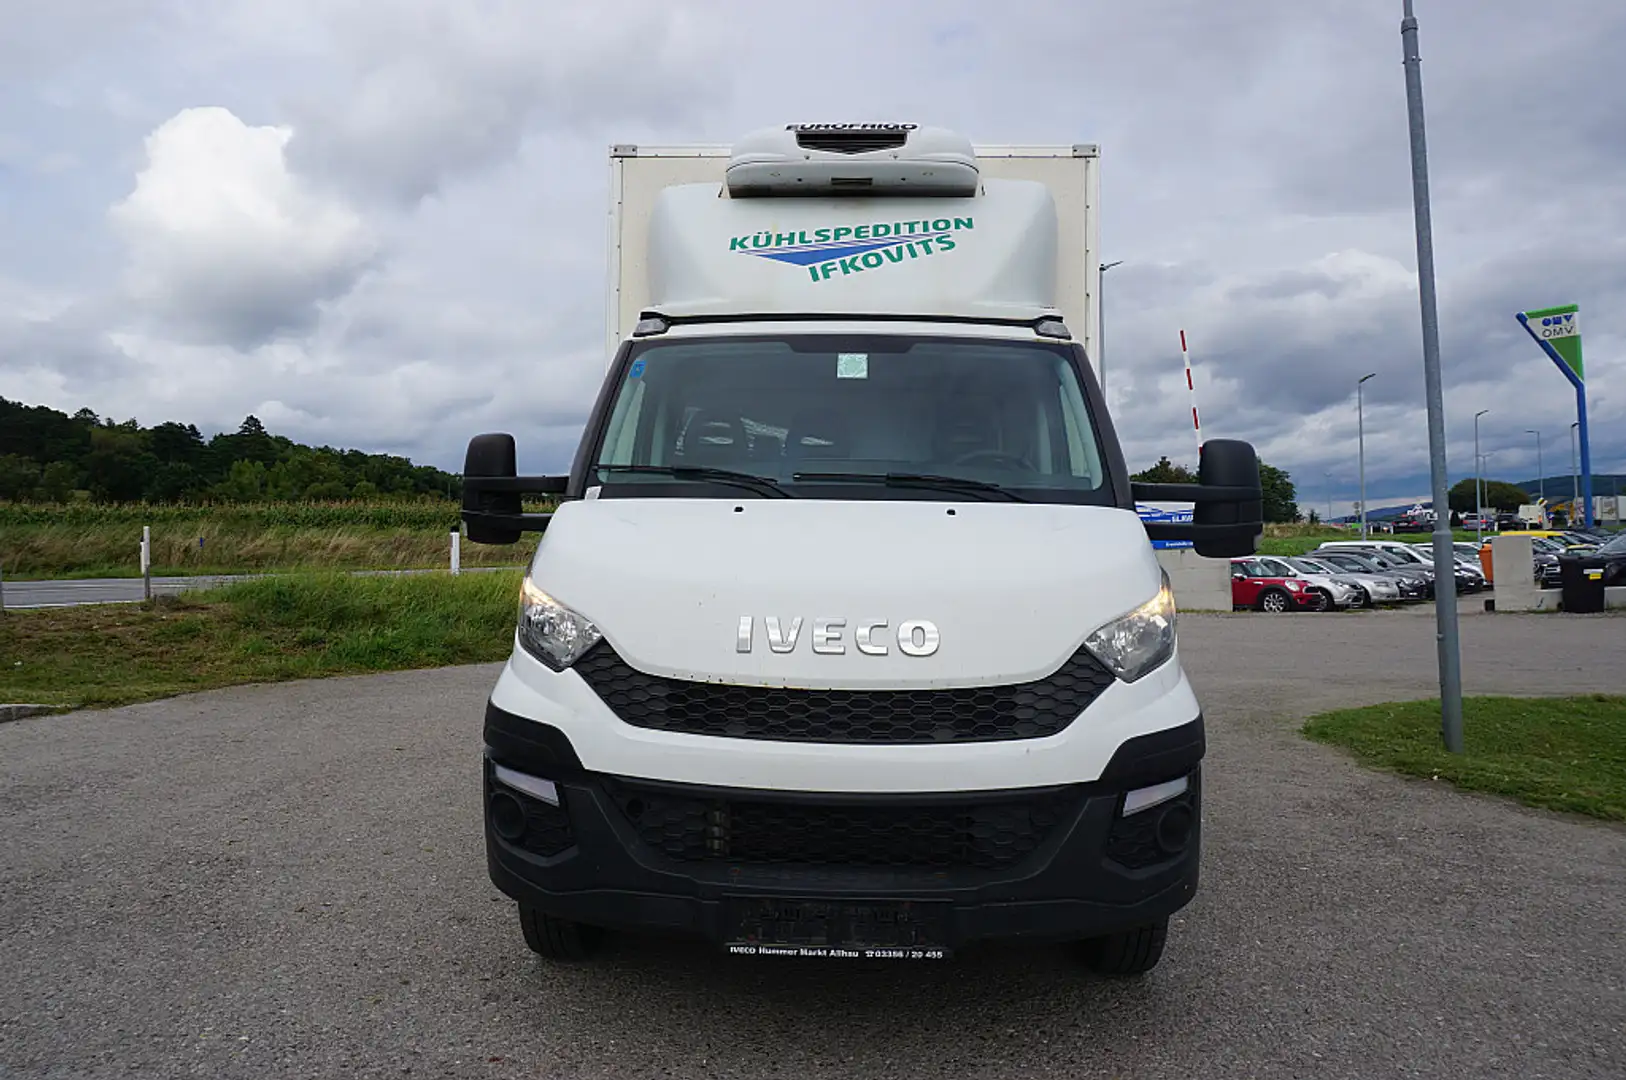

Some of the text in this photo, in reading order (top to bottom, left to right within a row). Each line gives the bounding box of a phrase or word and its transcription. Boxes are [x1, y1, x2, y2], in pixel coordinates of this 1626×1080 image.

[729, 217, 974, 251] KÜHLSPEDITION
[808, 234, 956, 282] IFKOVITS
[1541, 326, 1574, 338] OMV
[736, 615, 940, 657] IVECO
[729, 946, 756, 955] IVECO
